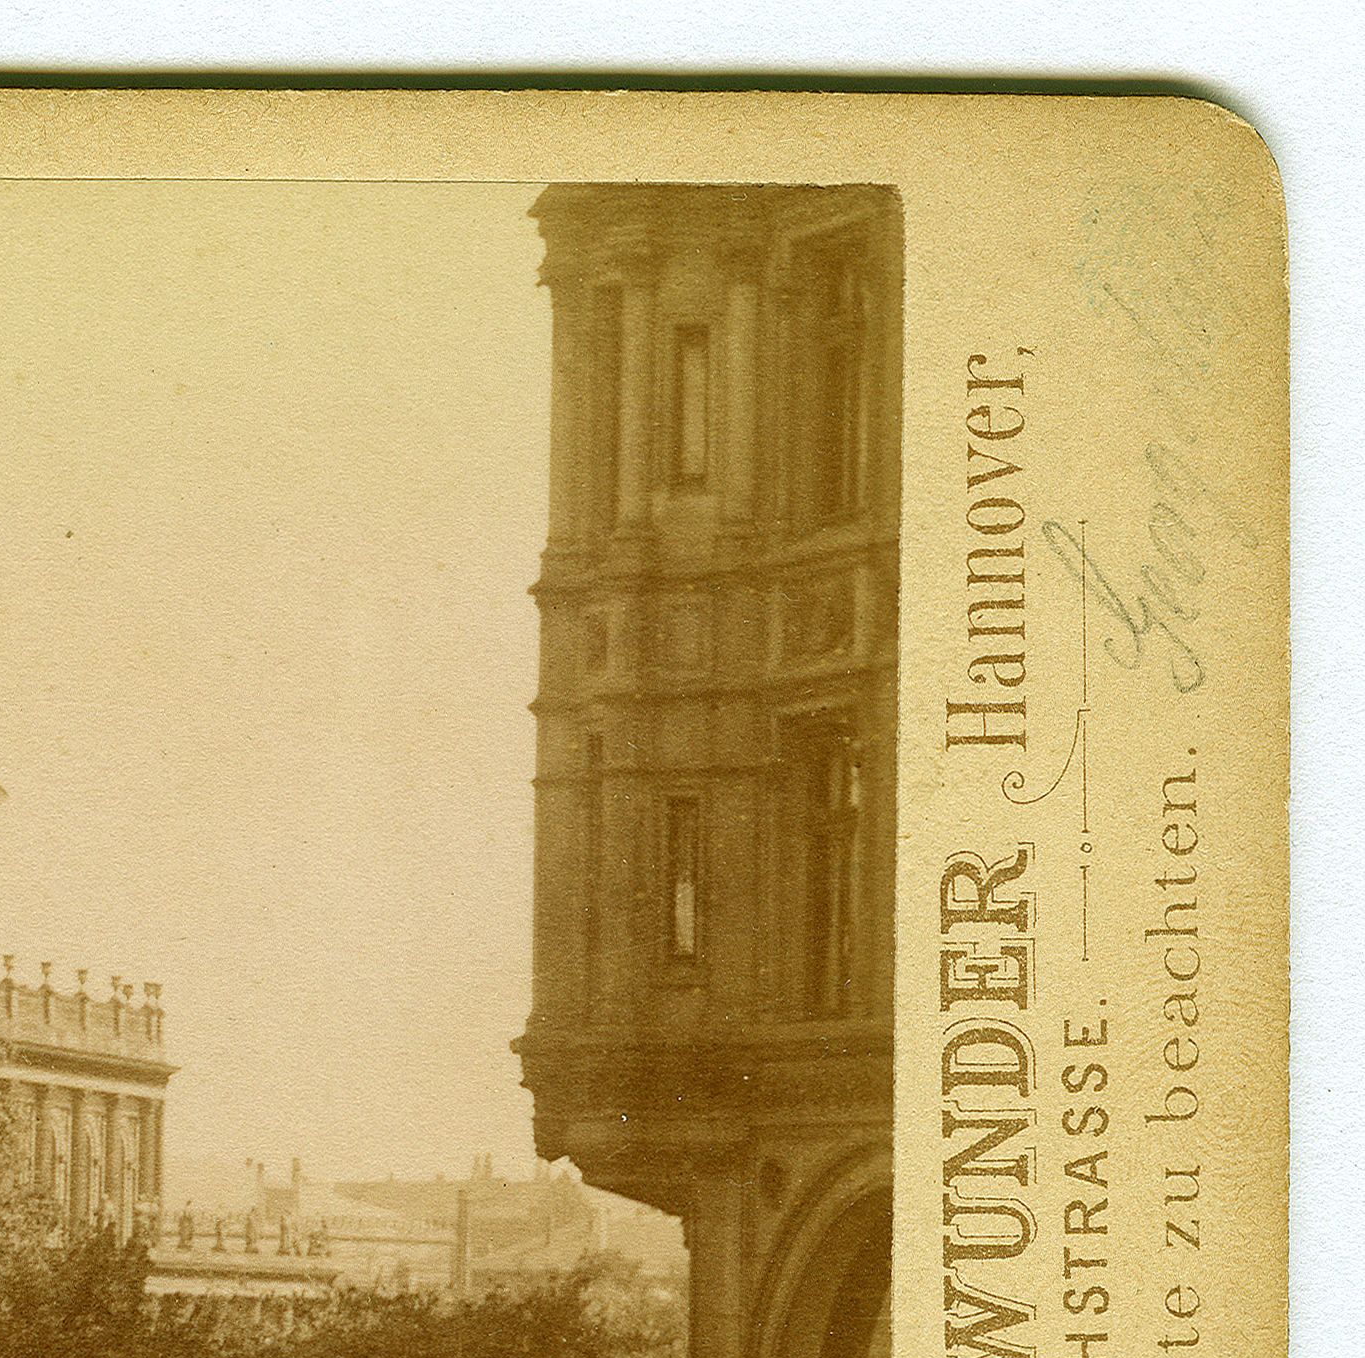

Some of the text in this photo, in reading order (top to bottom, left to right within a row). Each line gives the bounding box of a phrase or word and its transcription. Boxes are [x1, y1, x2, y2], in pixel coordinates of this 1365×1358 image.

[944, 347, 1037, 754] Hannover,
[1144, 747, 1202, 1124] beachten.
[1164, 1165, 1202, 1250] zu
